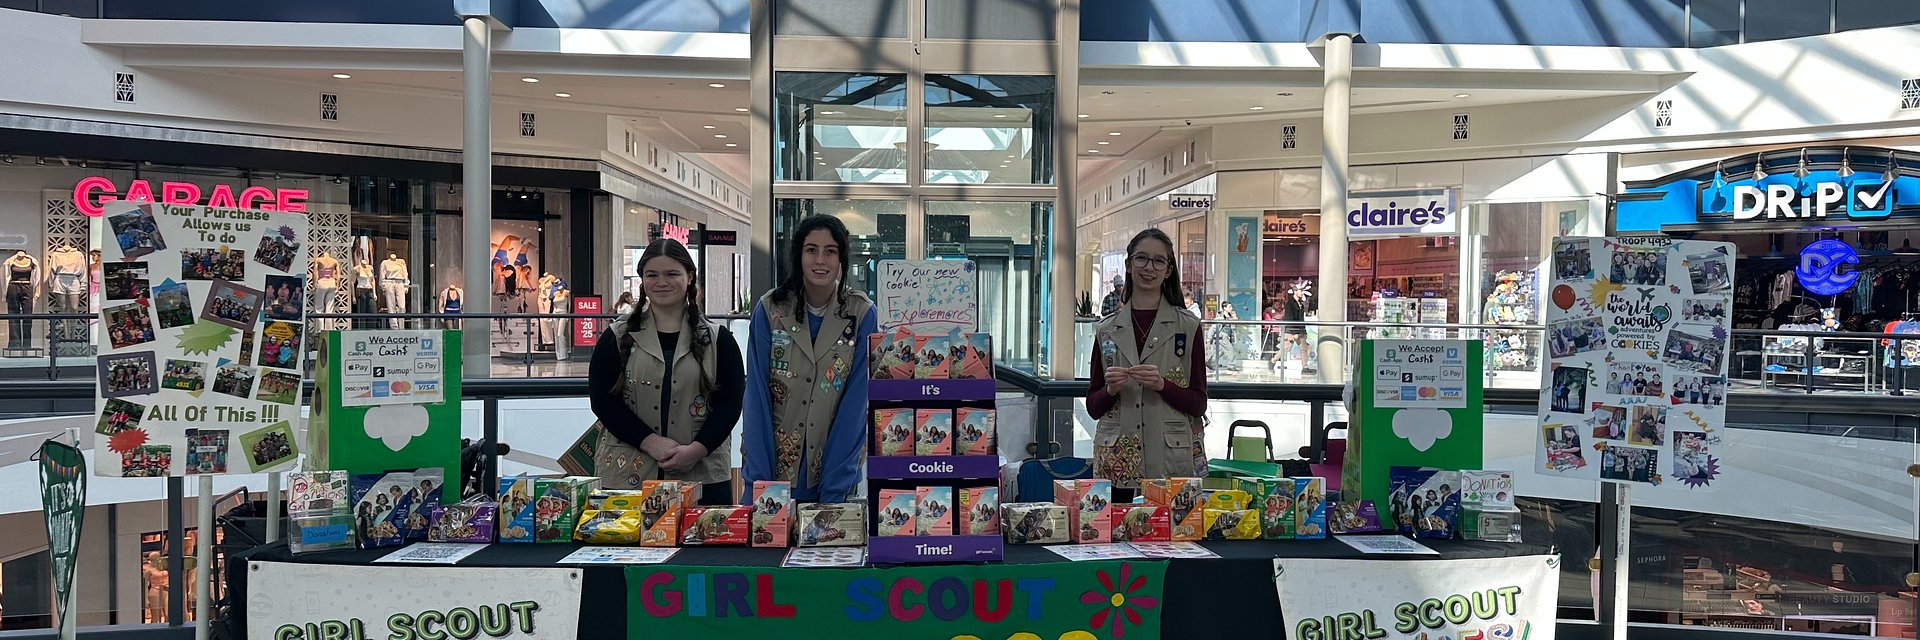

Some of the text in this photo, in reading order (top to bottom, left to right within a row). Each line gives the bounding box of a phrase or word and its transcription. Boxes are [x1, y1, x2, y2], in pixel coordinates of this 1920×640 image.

[1171, 197, 1210, 209] claire's
[161, 203, 270, 221] Your Purchase
[1347, 200, 1446, 227] claire's
[182, 217, 251, 232] Allows us
[198, 230, 236, 244] To do
[1617, 236, 1672, 247] TROOP 4932
[886, 262, 960, 281] Try our new
[886, 276, 922, 290] cookie!
[1609, 292, 1625, 303] the
[578, 301, 597, 310] SALE
[1607, 300, 1653, 316] world
[580, 321, 593, 330] '20
[1613, 313, 1663, 332] awaits
[580, 329, 593, 338] '25
[1619, 326, 1655, 334] adventures
[368, 336, 419, 345] We Accept
[1646, 333, 1656, 341] by
[1398, 344, 1445, 353] We Accept
[1611, 339, 1660, 350] COOKIES
[378, 345, 409, 356] Cash$
[1408, 354, 1434, 363] Cash$
[354, 363, 369, 371] Pay
[424, 363, 437, 371] Pay
[921, 384, 941, 395] It's
[146, 404, 280, 423] All Of This !!!
[908, 461, 954, 473] Cookie
[915, 543, 952, 556] Time!
[1637, 555, 1667, 564] SEPHORA
[640, 571, 1056, 622] GIRL SCOUT
[1832, 595, 1870, 603] STUDIO
[1295, 609, 1387, 640] GIRL
[1394, 585, 1522, 634] SCOUT
[274, 600, 539, 640] GIRL SCOUT
